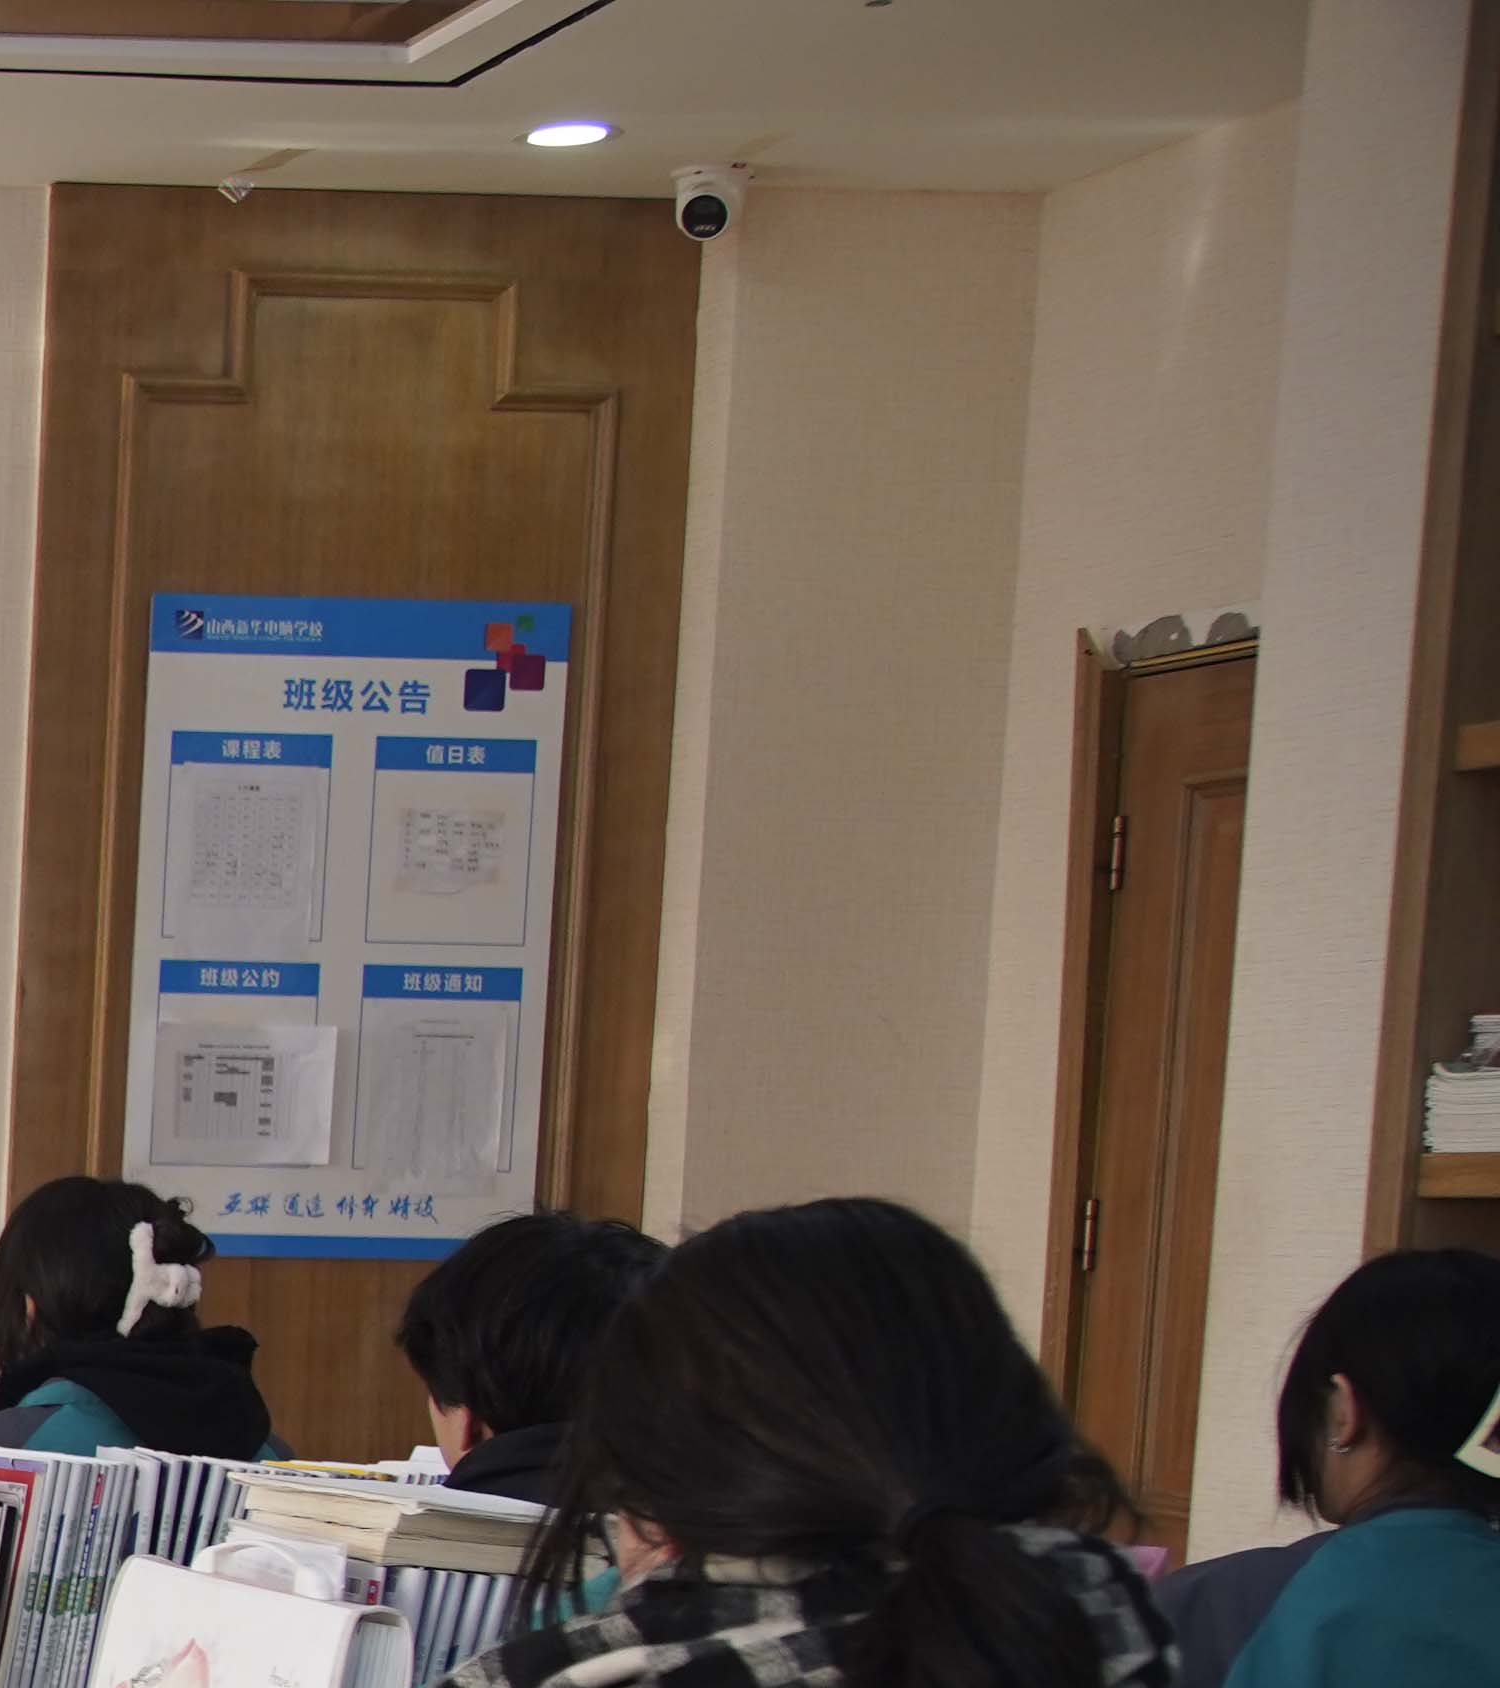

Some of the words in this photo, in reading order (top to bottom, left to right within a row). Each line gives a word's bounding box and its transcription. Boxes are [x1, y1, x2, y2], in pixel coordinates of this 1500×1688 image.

[283, 678, 431, 715] 班级公告
[222, 738, 282, 761] 课程表
[426, 744, 486, 766] 值日表
[200, 967, 280, 989] 班级公约
[403, 972, 483, 994] 班级通知
